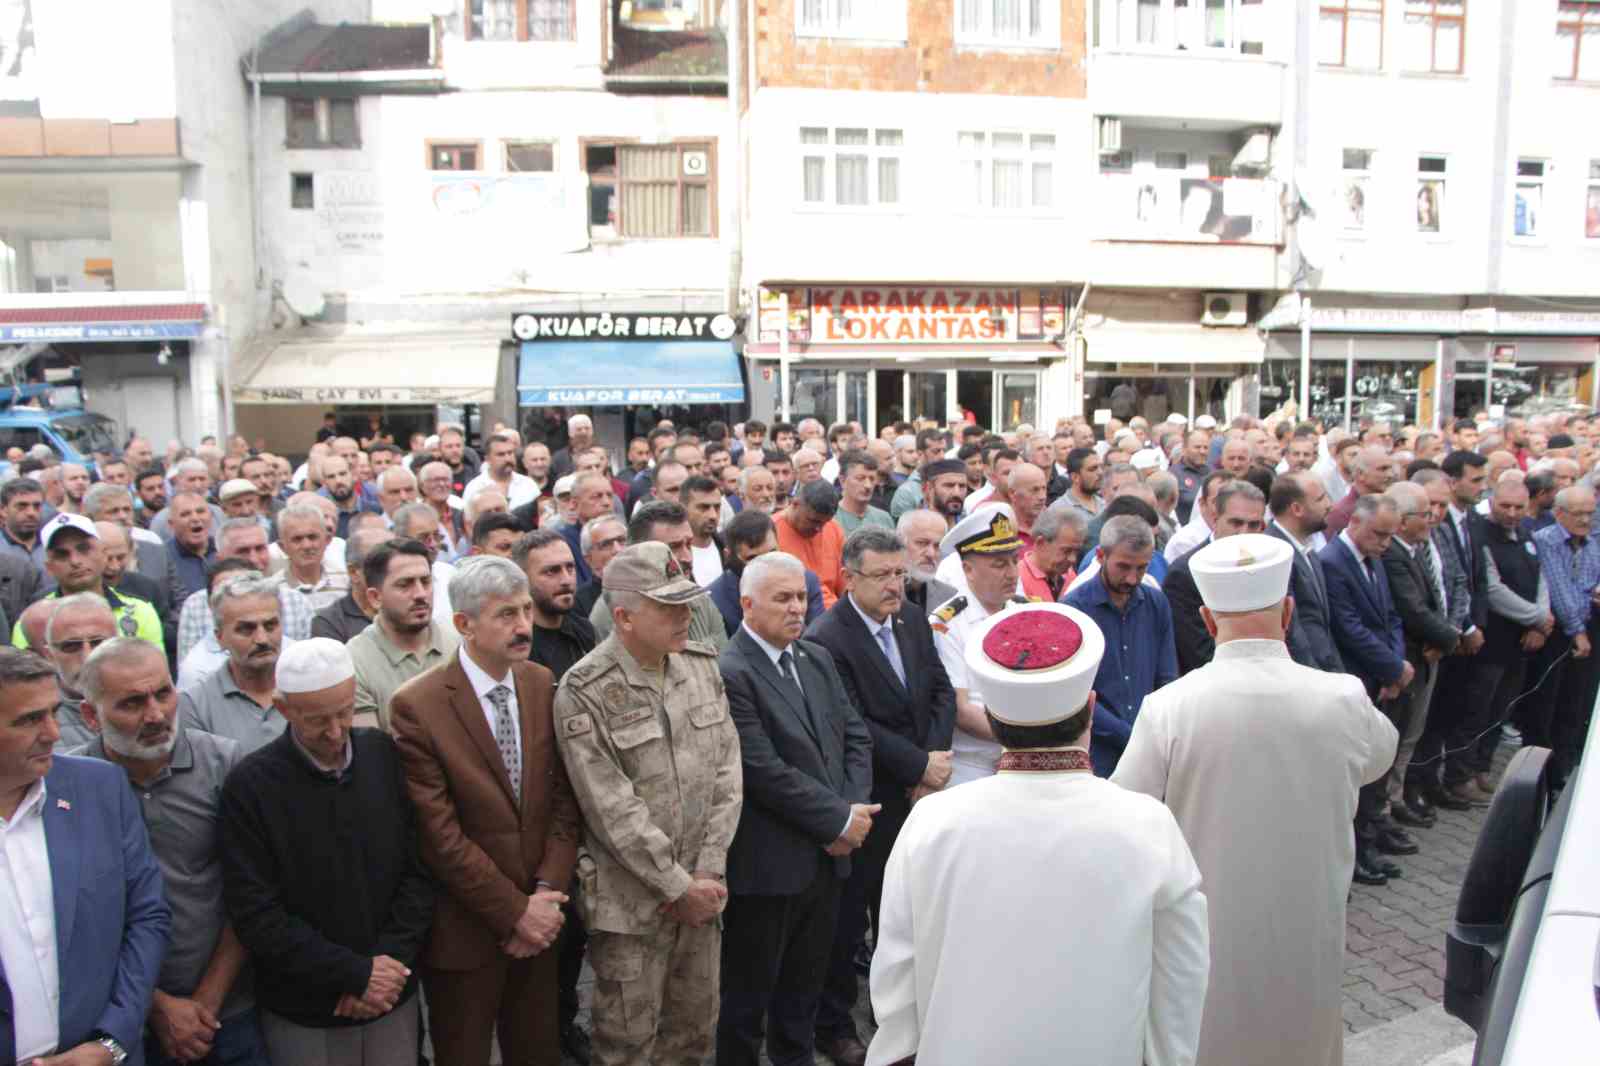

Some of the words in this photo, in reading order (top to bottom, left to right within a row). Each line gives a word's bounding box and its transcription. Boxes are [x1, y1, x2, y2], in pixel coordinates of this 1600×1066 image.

[812, 289, 1015, 314] KARAKAZAN
[539, 313, 630, 336] KUAFÖR
[635, 316, 708, 336] BERAT
[825, 317, 1005, 339] LOKANTASI
[628, 389, 688, 401] BERAT
